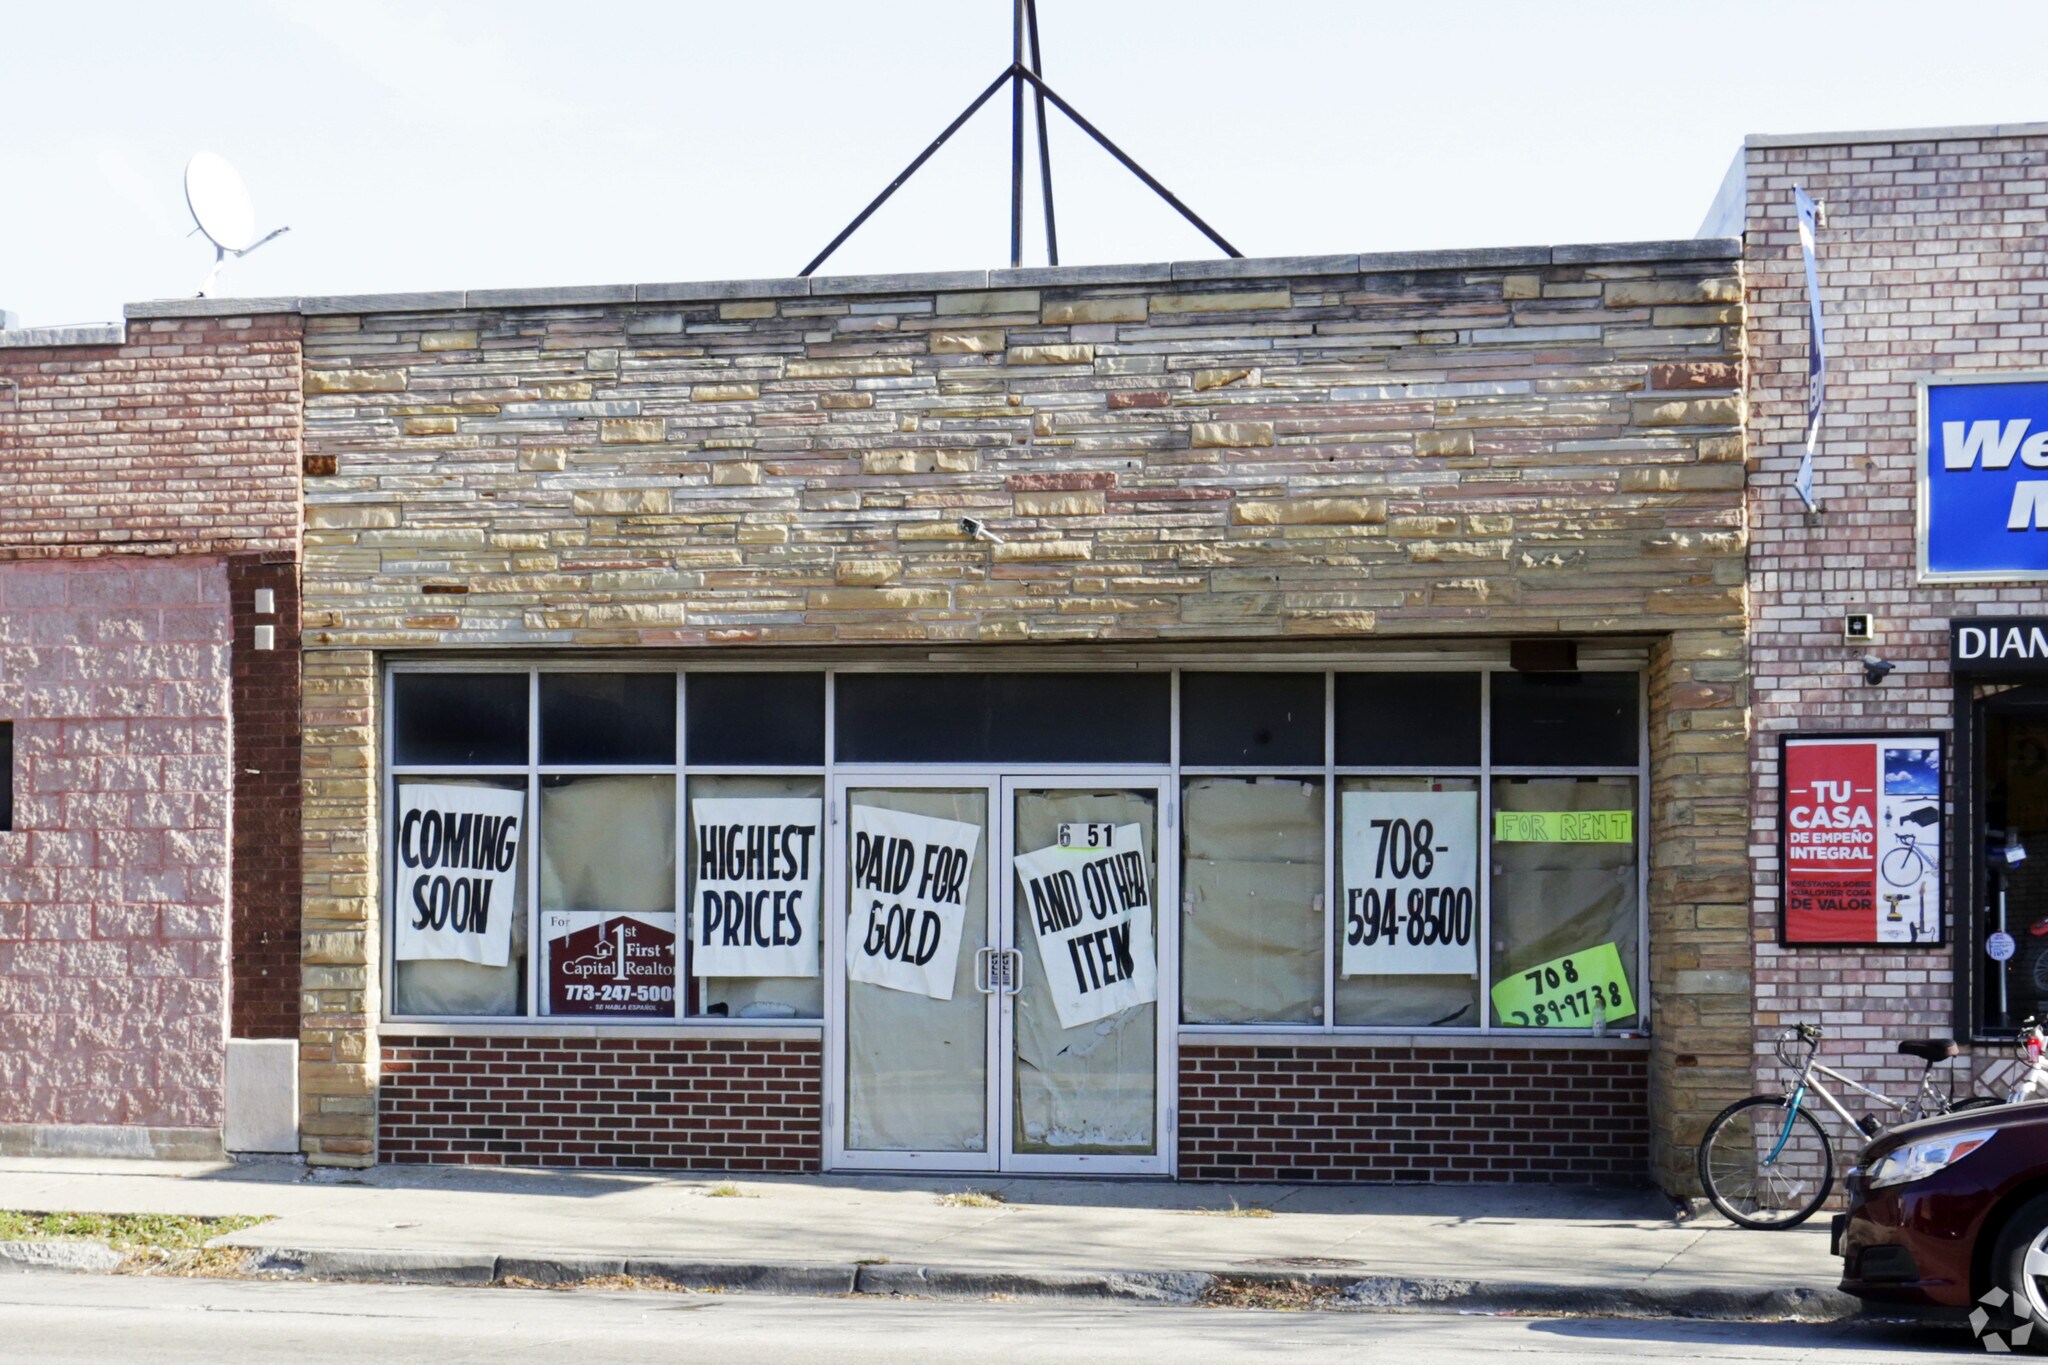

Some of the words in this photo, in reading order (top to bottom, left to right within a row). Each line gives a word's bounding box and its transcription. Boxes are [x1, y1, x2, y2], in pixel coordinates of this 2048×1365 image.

[1811, 781, 1852, 804] TU
[1502, 814, 1549, 840] FOR
[1561, 813, 1628, 840] RENT
[1790, 805, 1873, 829] CASA
[402, 809, 517, 873] COMING
[700, 824, 816, 881] HIGHEST
[1370, 818, 1448, 880] 708-
[1790, 832, 1810, 844] DE
[1812, 829, 1873, 844] EMPEÑO
[856, 831, 914, 895] PAID
[917, 844, 968, 904] FOR
[1790, 846, 1873, 860] INTEGRAL
[412, 875, 493, 934] SOON
[1029, 869, 1083, 937] AND
[1082, 850, 1147, 921] OTHER
[1791, 888, 1843, 897] CUALQUIER
[1846, 888, 1873, 897] COSA
[1791, 898, 1813, 910] DE
[1816, 898, 1873, 911] VALOR
[551, 916, 571, 927] For
[702, 890, 803, 947] PRICES
[1348, 886, 1473, 946] 594-8500
[863, 900, 941, 966] GOLD
[626, 943, 660, 957] First
[562, 960, 617, 979] Capital
[1525, 959, 1578, 996] 708
